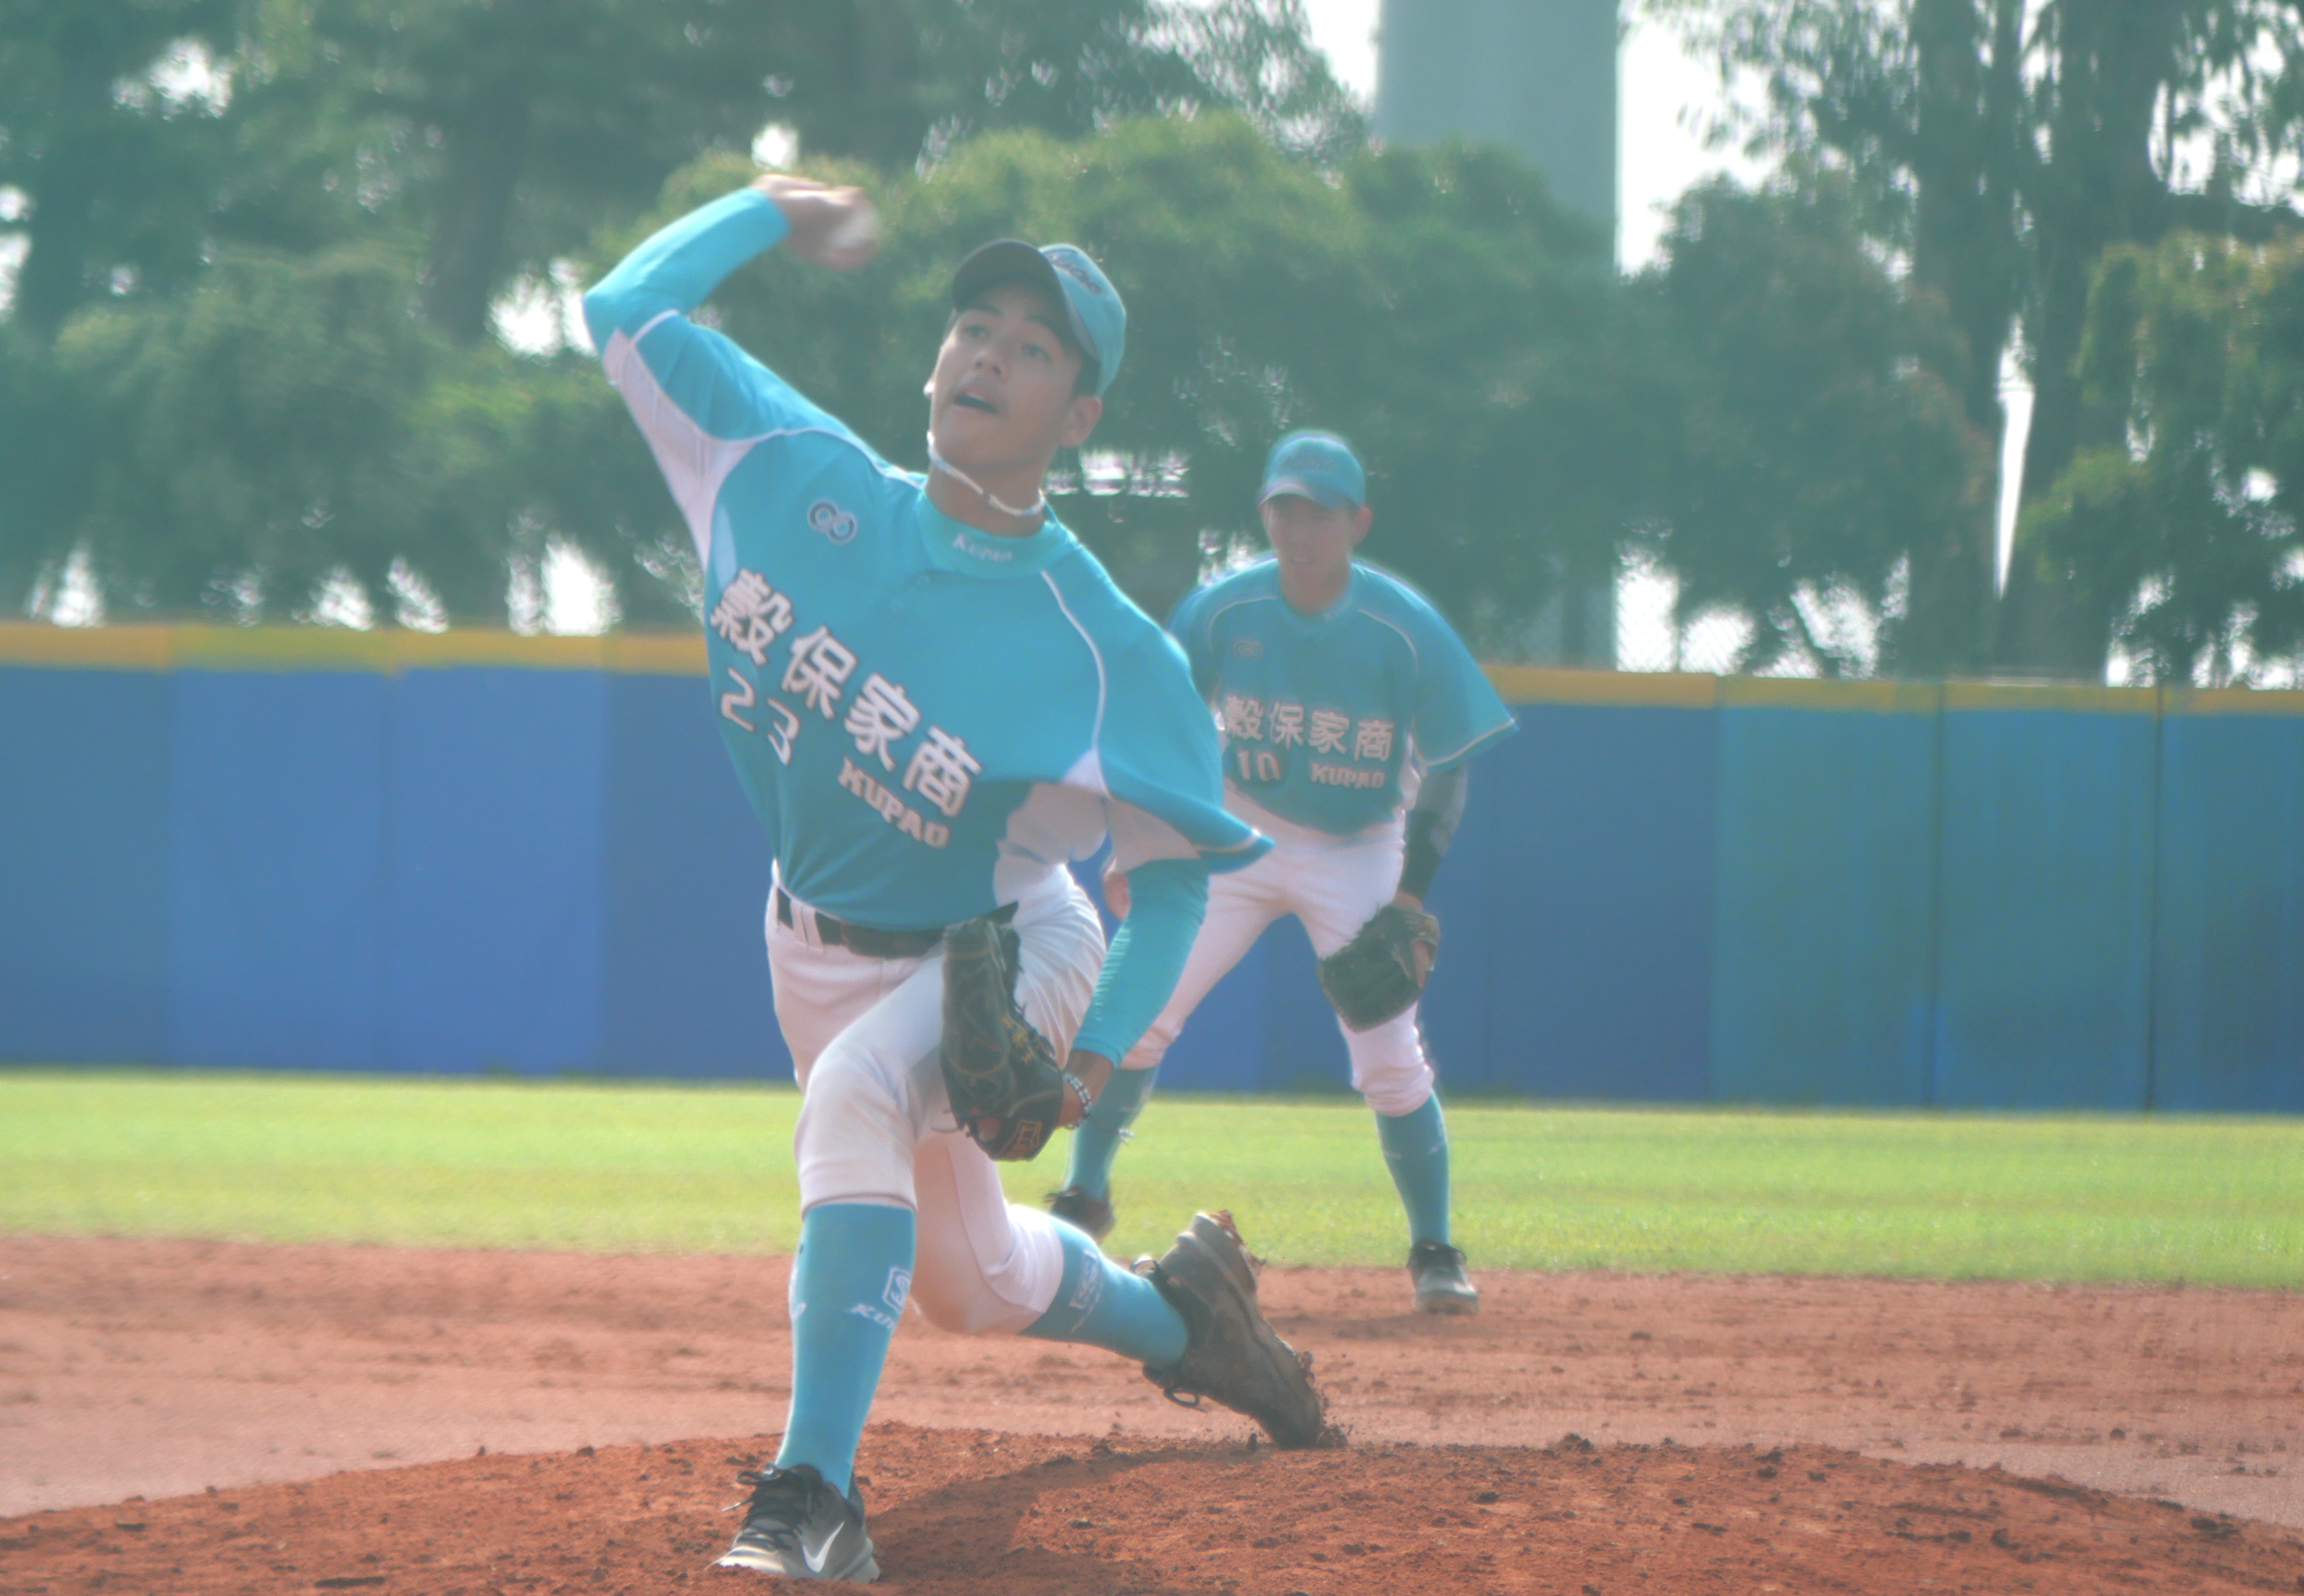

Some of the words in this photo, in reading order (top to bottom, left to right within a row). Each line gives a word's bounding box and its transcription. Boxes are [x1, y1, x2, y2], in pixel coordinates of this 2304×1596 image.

[721, 668, 800, 765] 23
[1237, 750, 1279, 780] 10
[1311, 762, 1385, 788] KUPAO
[838, 757, 950, 848] KUPAO
